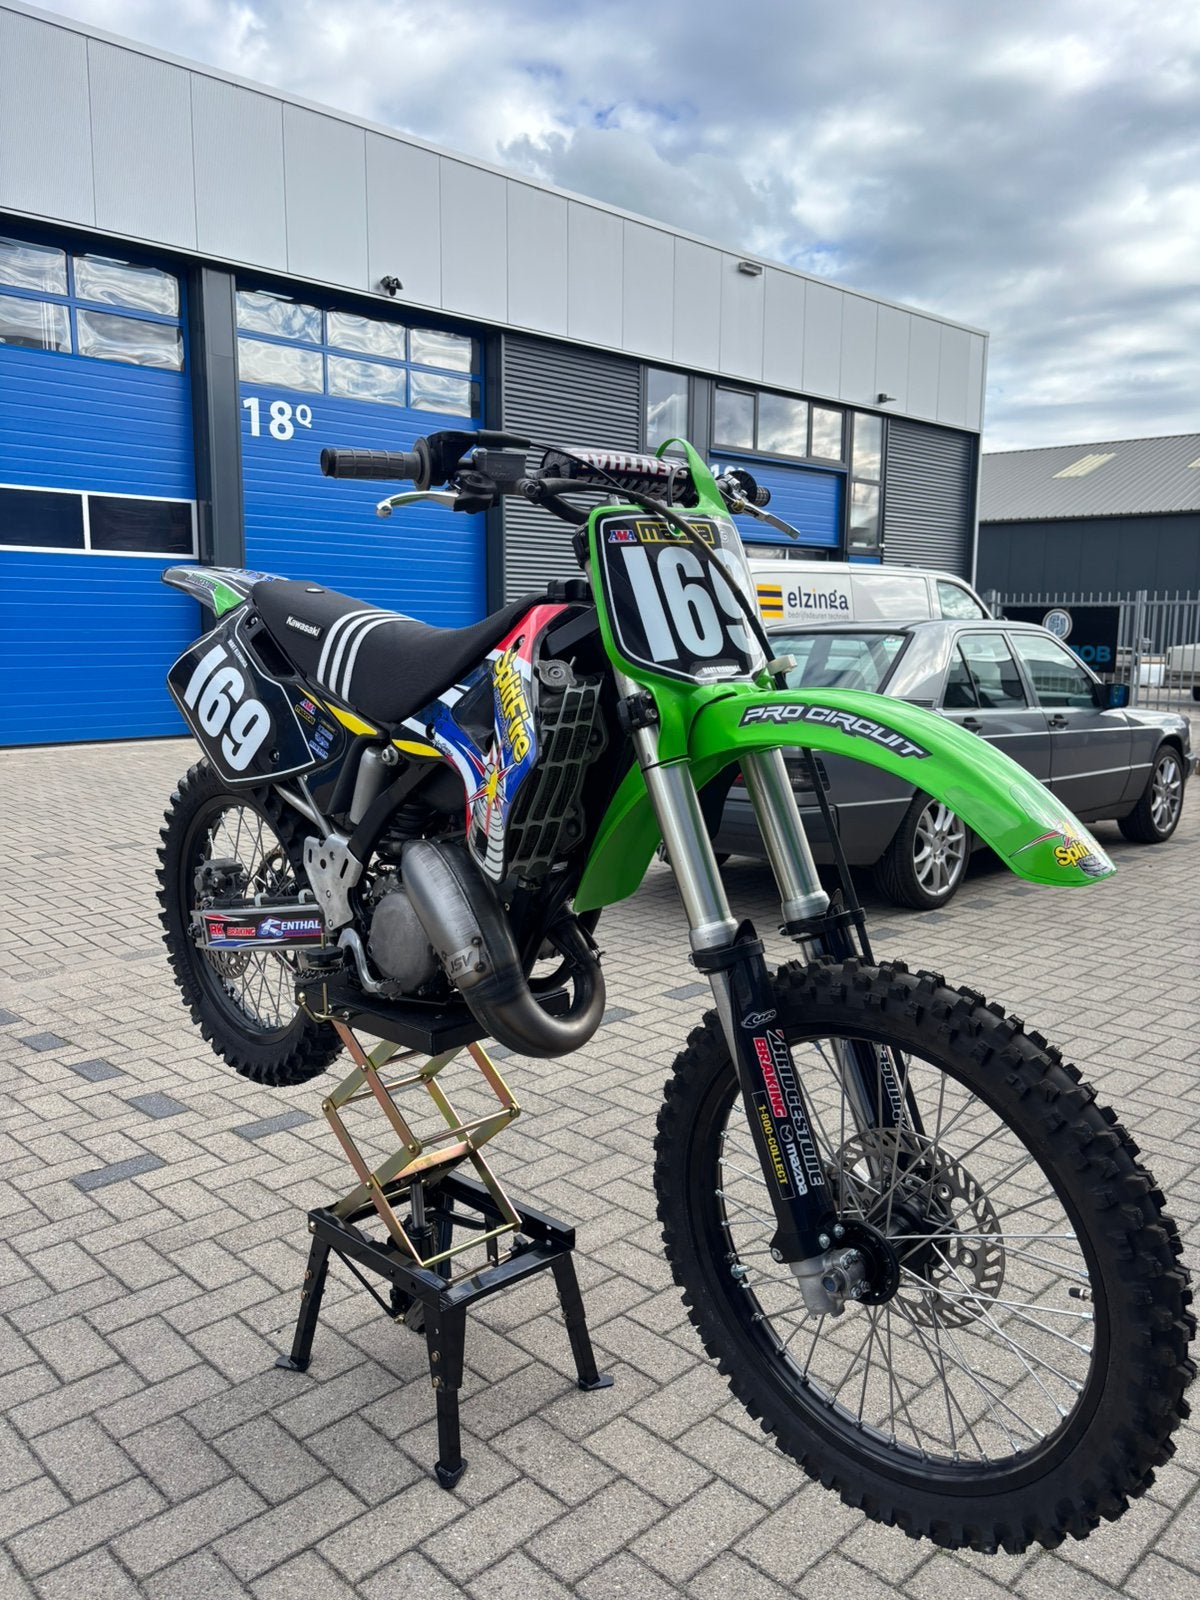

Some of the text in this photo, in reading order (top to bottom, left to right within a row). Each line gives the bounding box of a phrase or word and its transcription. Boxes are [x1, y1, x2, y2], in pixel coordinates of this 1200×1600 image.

[608, 529, 638, 544] AMA
[286, 615, 321, 637] Kawasaki
[620, 545, 763, 662] 169
[787, 584, 850, 611] elzinga
[183, 644, 271, 771] 169
[743, 704, 925, 757] PRO CIRCUIT
[752, 1036, 788, 1118] BRAKING
[766, 1028, 826, 1186] BRIDGESTONE
[758, 1105, 789, 1185] 1-800-COLLECT
[786, 1143, 809, 1195] mazda
